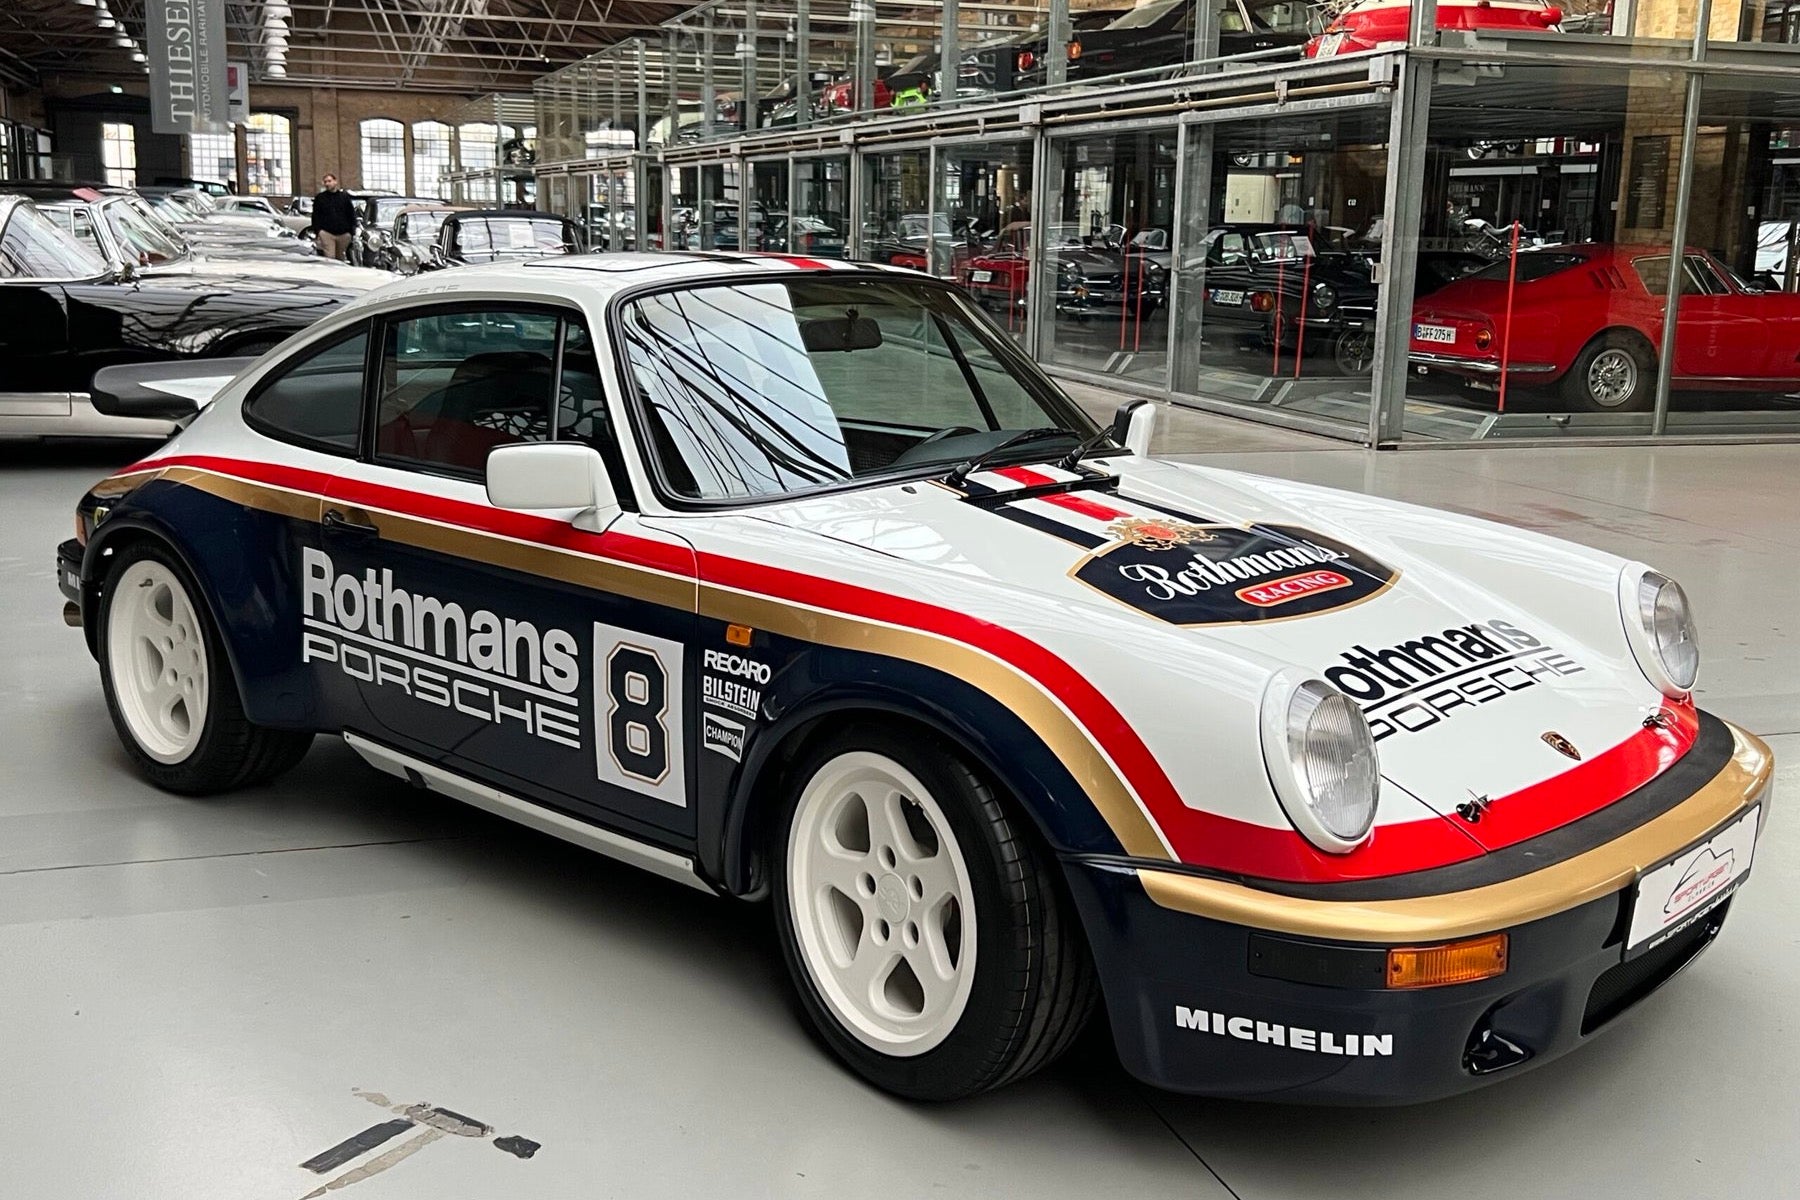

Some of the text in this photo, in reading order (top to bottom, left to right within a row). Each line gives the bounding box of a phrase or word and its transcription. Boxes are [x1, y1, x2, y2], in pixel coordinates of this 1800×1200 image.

[200, 50, 211, 122] AUTOMOBILE
[1119, 539, 1349, 600] Rothmans
[1247, 573, 1340, 602] RACING
[303, 545, 580, 694] Rothmans
[303, 631, 581, 750] PORSCHE
[704, 649, 771, 685] RECARO
[1324, 619, 1542, 704] othmans
[606, 640, 671, 788] 8
[704, 675, 760, 712] BILSTEIN
[706, 725, 743, 751] CHAMPION
[1175, 1005, 1393, 1057] MICHELIN
